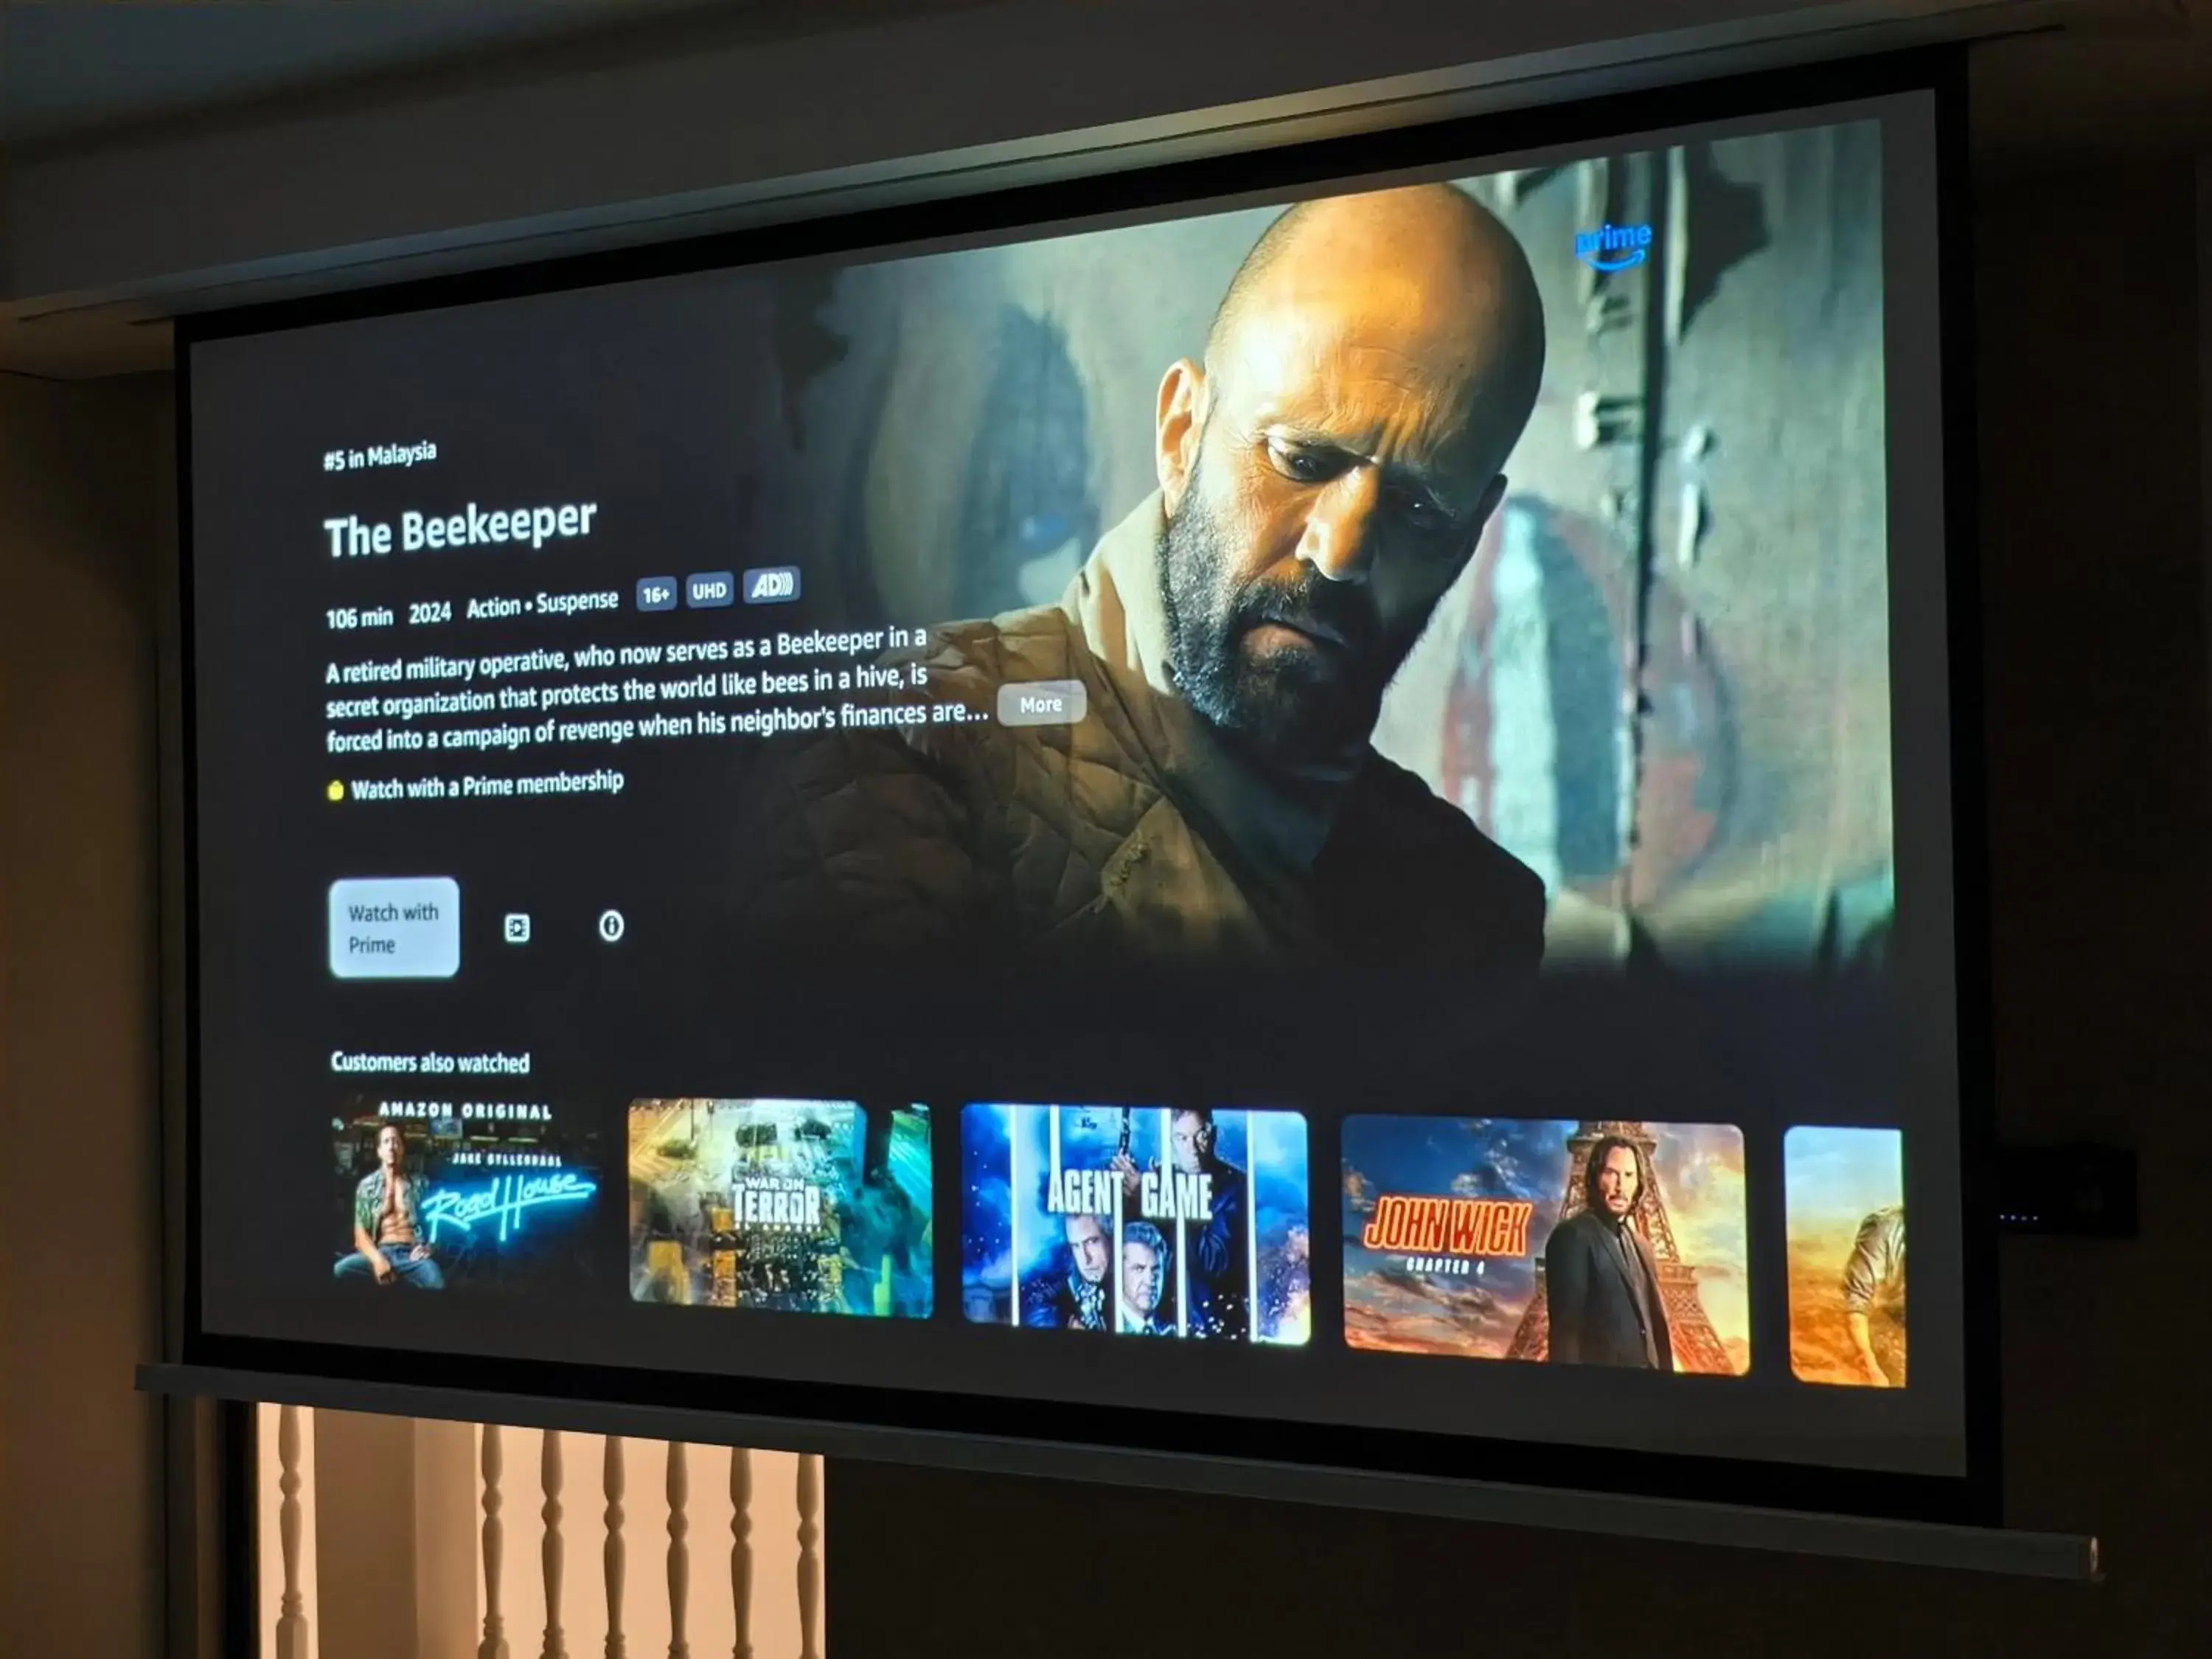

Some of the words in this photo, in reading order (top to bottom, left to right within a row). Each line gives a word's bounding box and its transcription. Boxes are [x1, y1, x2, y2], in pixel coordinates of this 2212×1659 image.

[1576, 224, 1652, 257] prime
[324, 451, 345, 471] #5
[349, 449, 364, 468] in
[368, 440, 437, 468] Malaysia
[324, 515, 392, 557] The
[402, 502, 597, 549] Beekeeper
[643, 587, 669, 603] 16+
[692, 582, 727, 599] UHD
[327, 608, 357, 629] 106
[361, 608, 394, 627] min
[409, 601, 452, 625] 2024
[467, 597, 521, 619] Action
[537, 590, 619, 616] Suspense
[326, 664, 340, 684] A
[343, 658, 403, 682] retired
[406, 655, 475, 681] military
[479, 649, 570, 679] operative,
[574, 644, 615, 668] who
[620, 644, 662, 664] now
[666, 641, 728, 661] serves
[733, 641, 754, 658] as
[759, 639, 772, 656] a
[777, 629, 884, 658] Beekeeper
[889, 625, 908, 648] in
[914, 630, 926, 646] a
[327, 700, 379, 719] secret
[383, 690, 495, 720] organization
[499, 686, 537, 709] that
[541, 683, 619, 710] protects
[623, 678, 655, 700] the
[661, 674, 716, 698] world
[722, 672, 757, 695] like
[762, 671, 808, 694] bees
[814, 669, 833, 691] in
[838, 672, 850, 689] a
[857, 666, 905, 689] hive,
[911, 663, 927, 685] is
[1020, 696, 1062, 714] More
[327, 730, 383, 753] forced
[386, 728, 422, 750] into
[427, 732, 438, 748] a
[442, 723, 530, 751] campaign
[535, 720, 554, 742] of
[560, 718, 634, 744] revenge
[639, 714, 692, 737] when
[698, 711, 726, 734] his
[731, 707, 835, 737] neighbor's
[841, 704, 926, 728] finances
[352, 776, 403, 800] Watch
[408, 776, 443, 798] with
[448, 781, 459, 797] a
[464, 775, 513, 796] Prime
[517, 768, 625, 794] membership
[348, 904, 398, 922] Watch
[403, 902, 439, 920] with
[349, 936, 396, 954] Prime
[330, 1051, 417, 1072] Customers
[420, 1051, 455, 1074] also
[458, 1052, 530, 1074] watched
[378, 1102, 452, 1118] AMAZON
[462, 1102, 552, 1121] ORIGINAL
[745, 1178, 779, 1190] WAR
[782, 1178, 804, 1191] ON
[1048, 1169, 1124, 1214] AGENT
[1141, 1172, 1212, 1220] GAME
[421, 1177, 499, 1243] Road
[498, 1173, 597, 1242] House
[731, 1183, 820, 1224] TERROR
[1365, 1197, 1450, 1252] JOHN
[1450, 1200, 1532, 1256] WICK
[1406, 1257, 1469, 1274] CHAPTER
[1476, 1260, 1485, 1275] 4
